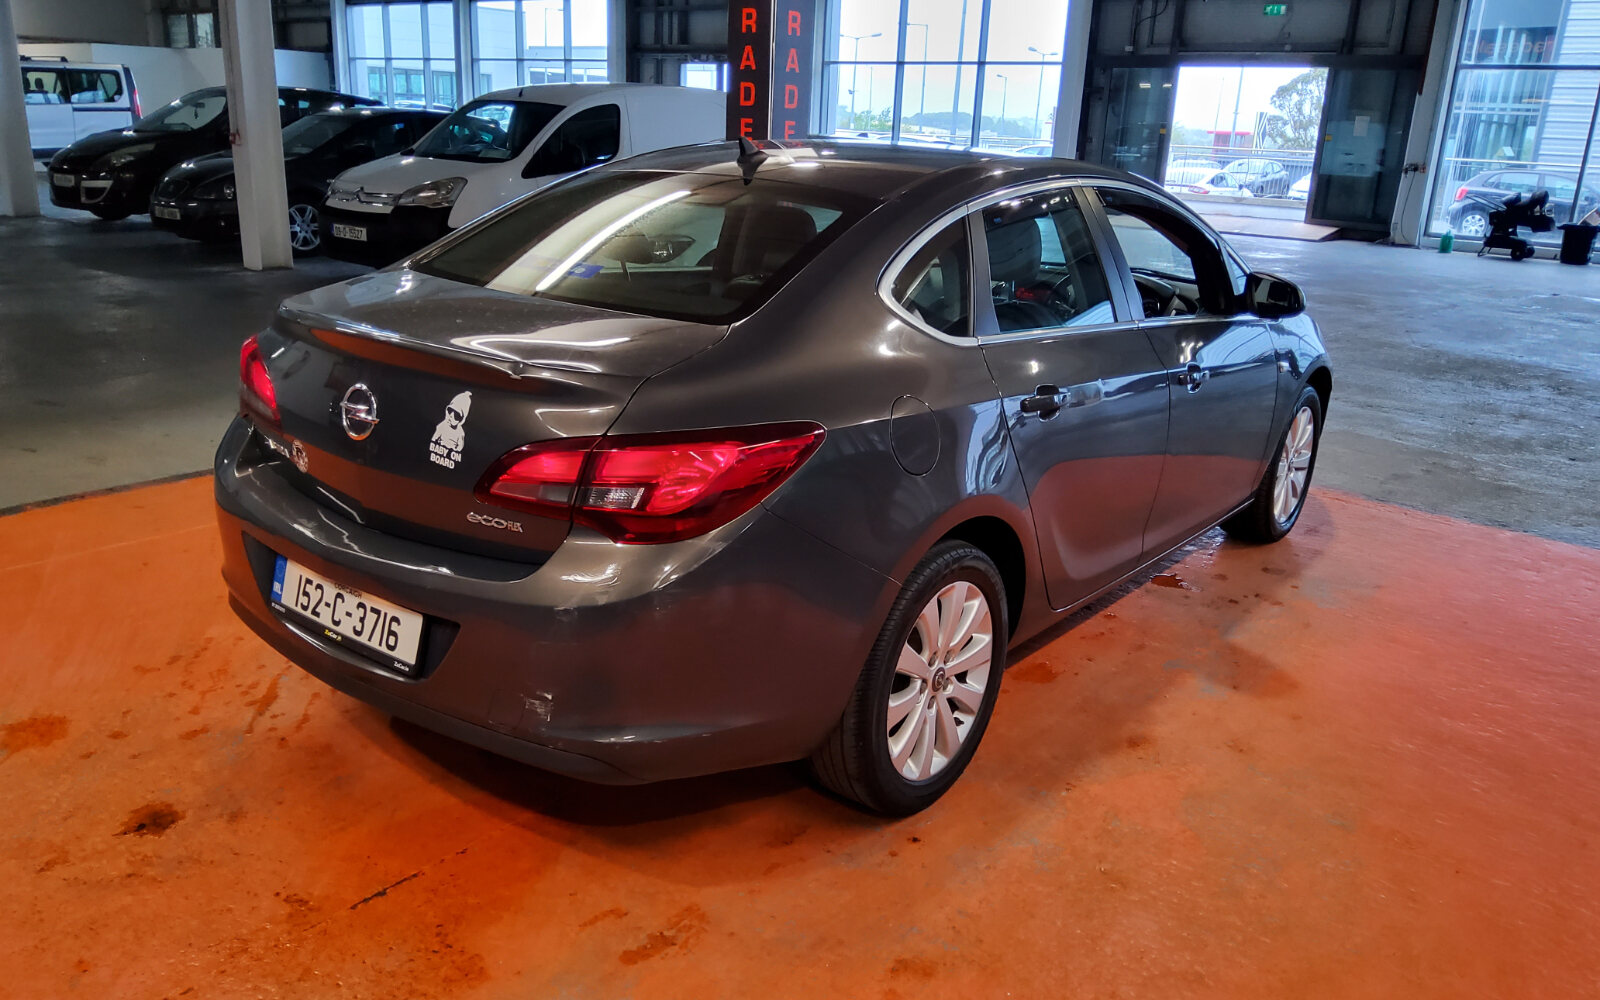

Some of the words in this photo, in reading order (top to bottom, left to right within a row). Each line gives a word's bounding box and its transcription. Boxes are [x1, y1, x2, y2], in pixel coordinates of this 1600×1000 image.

[429, 442, 449, 457] BABY
[450, 451, 462, 462] ON
[430, 453, 455, 469] BOARD
[294, 574, 401, 652] 152-C-3716
